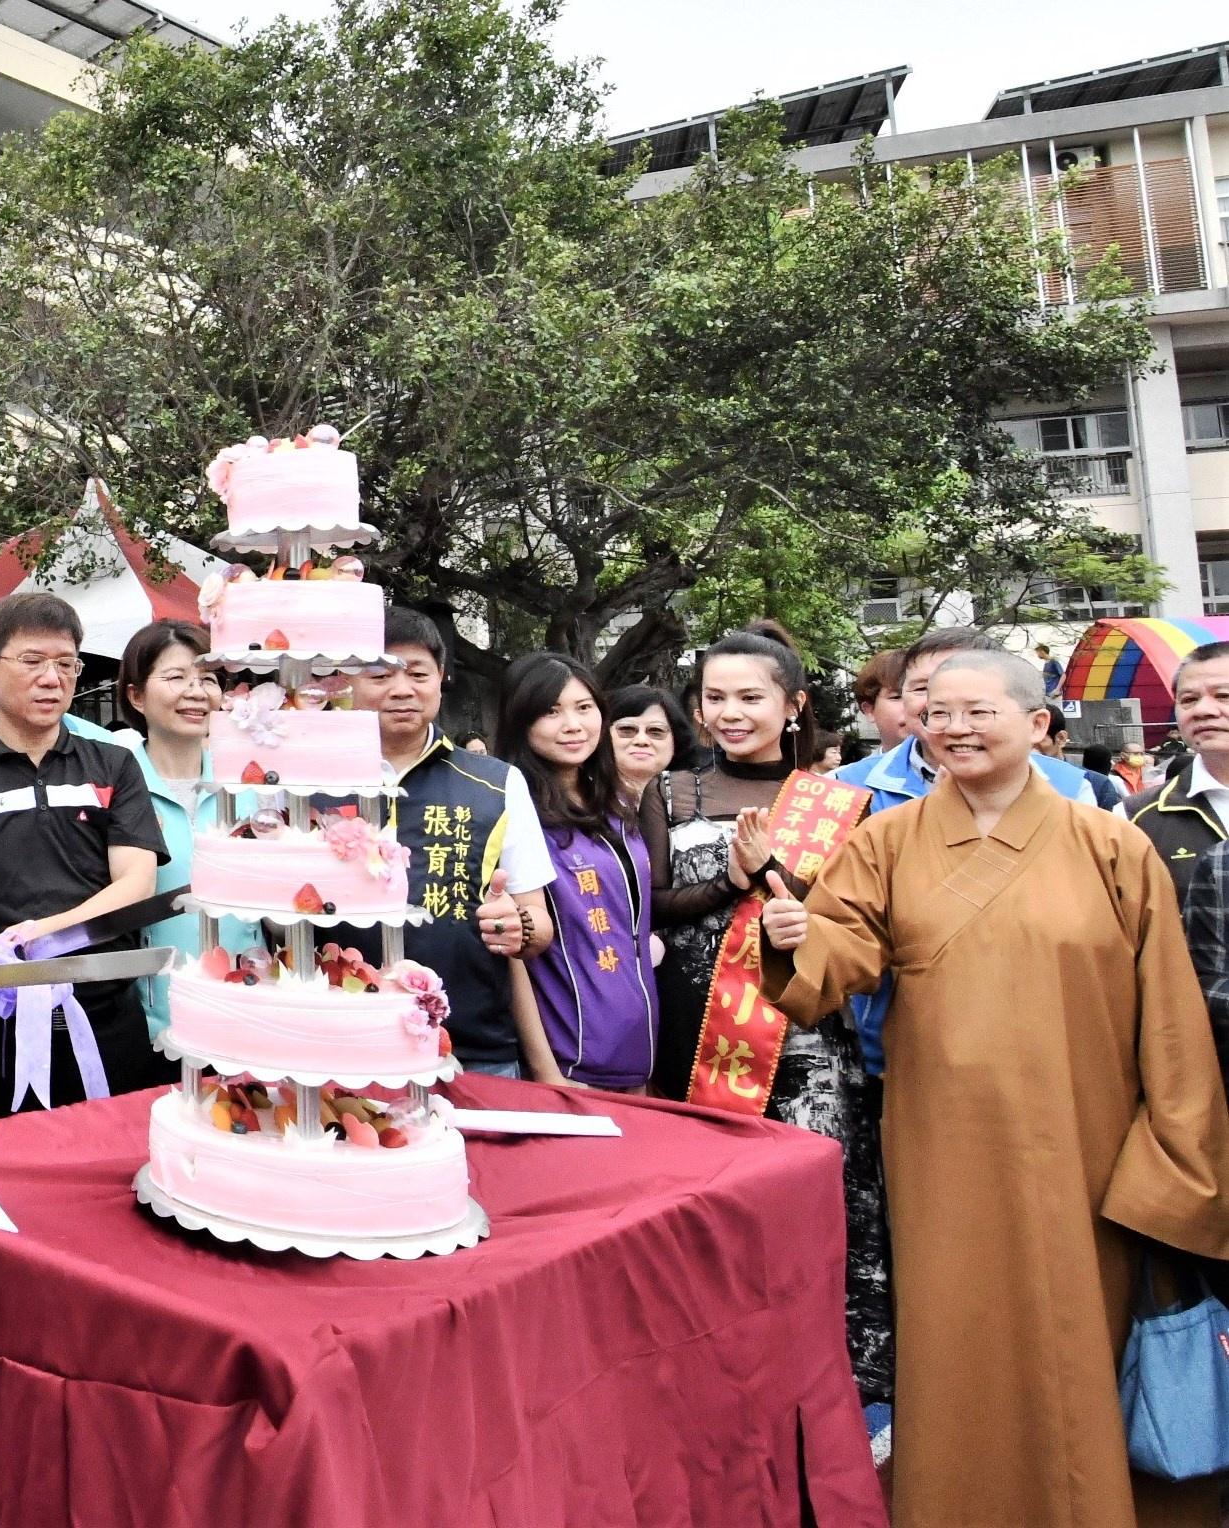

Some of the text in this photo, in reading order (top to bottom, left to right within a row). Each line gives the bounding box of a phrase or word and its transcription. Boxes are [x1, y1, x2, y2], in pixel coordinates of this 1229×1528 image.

[422, 805, 453, 918] 張育彬
[452, 805, 471, 921] 彰化市民代表
